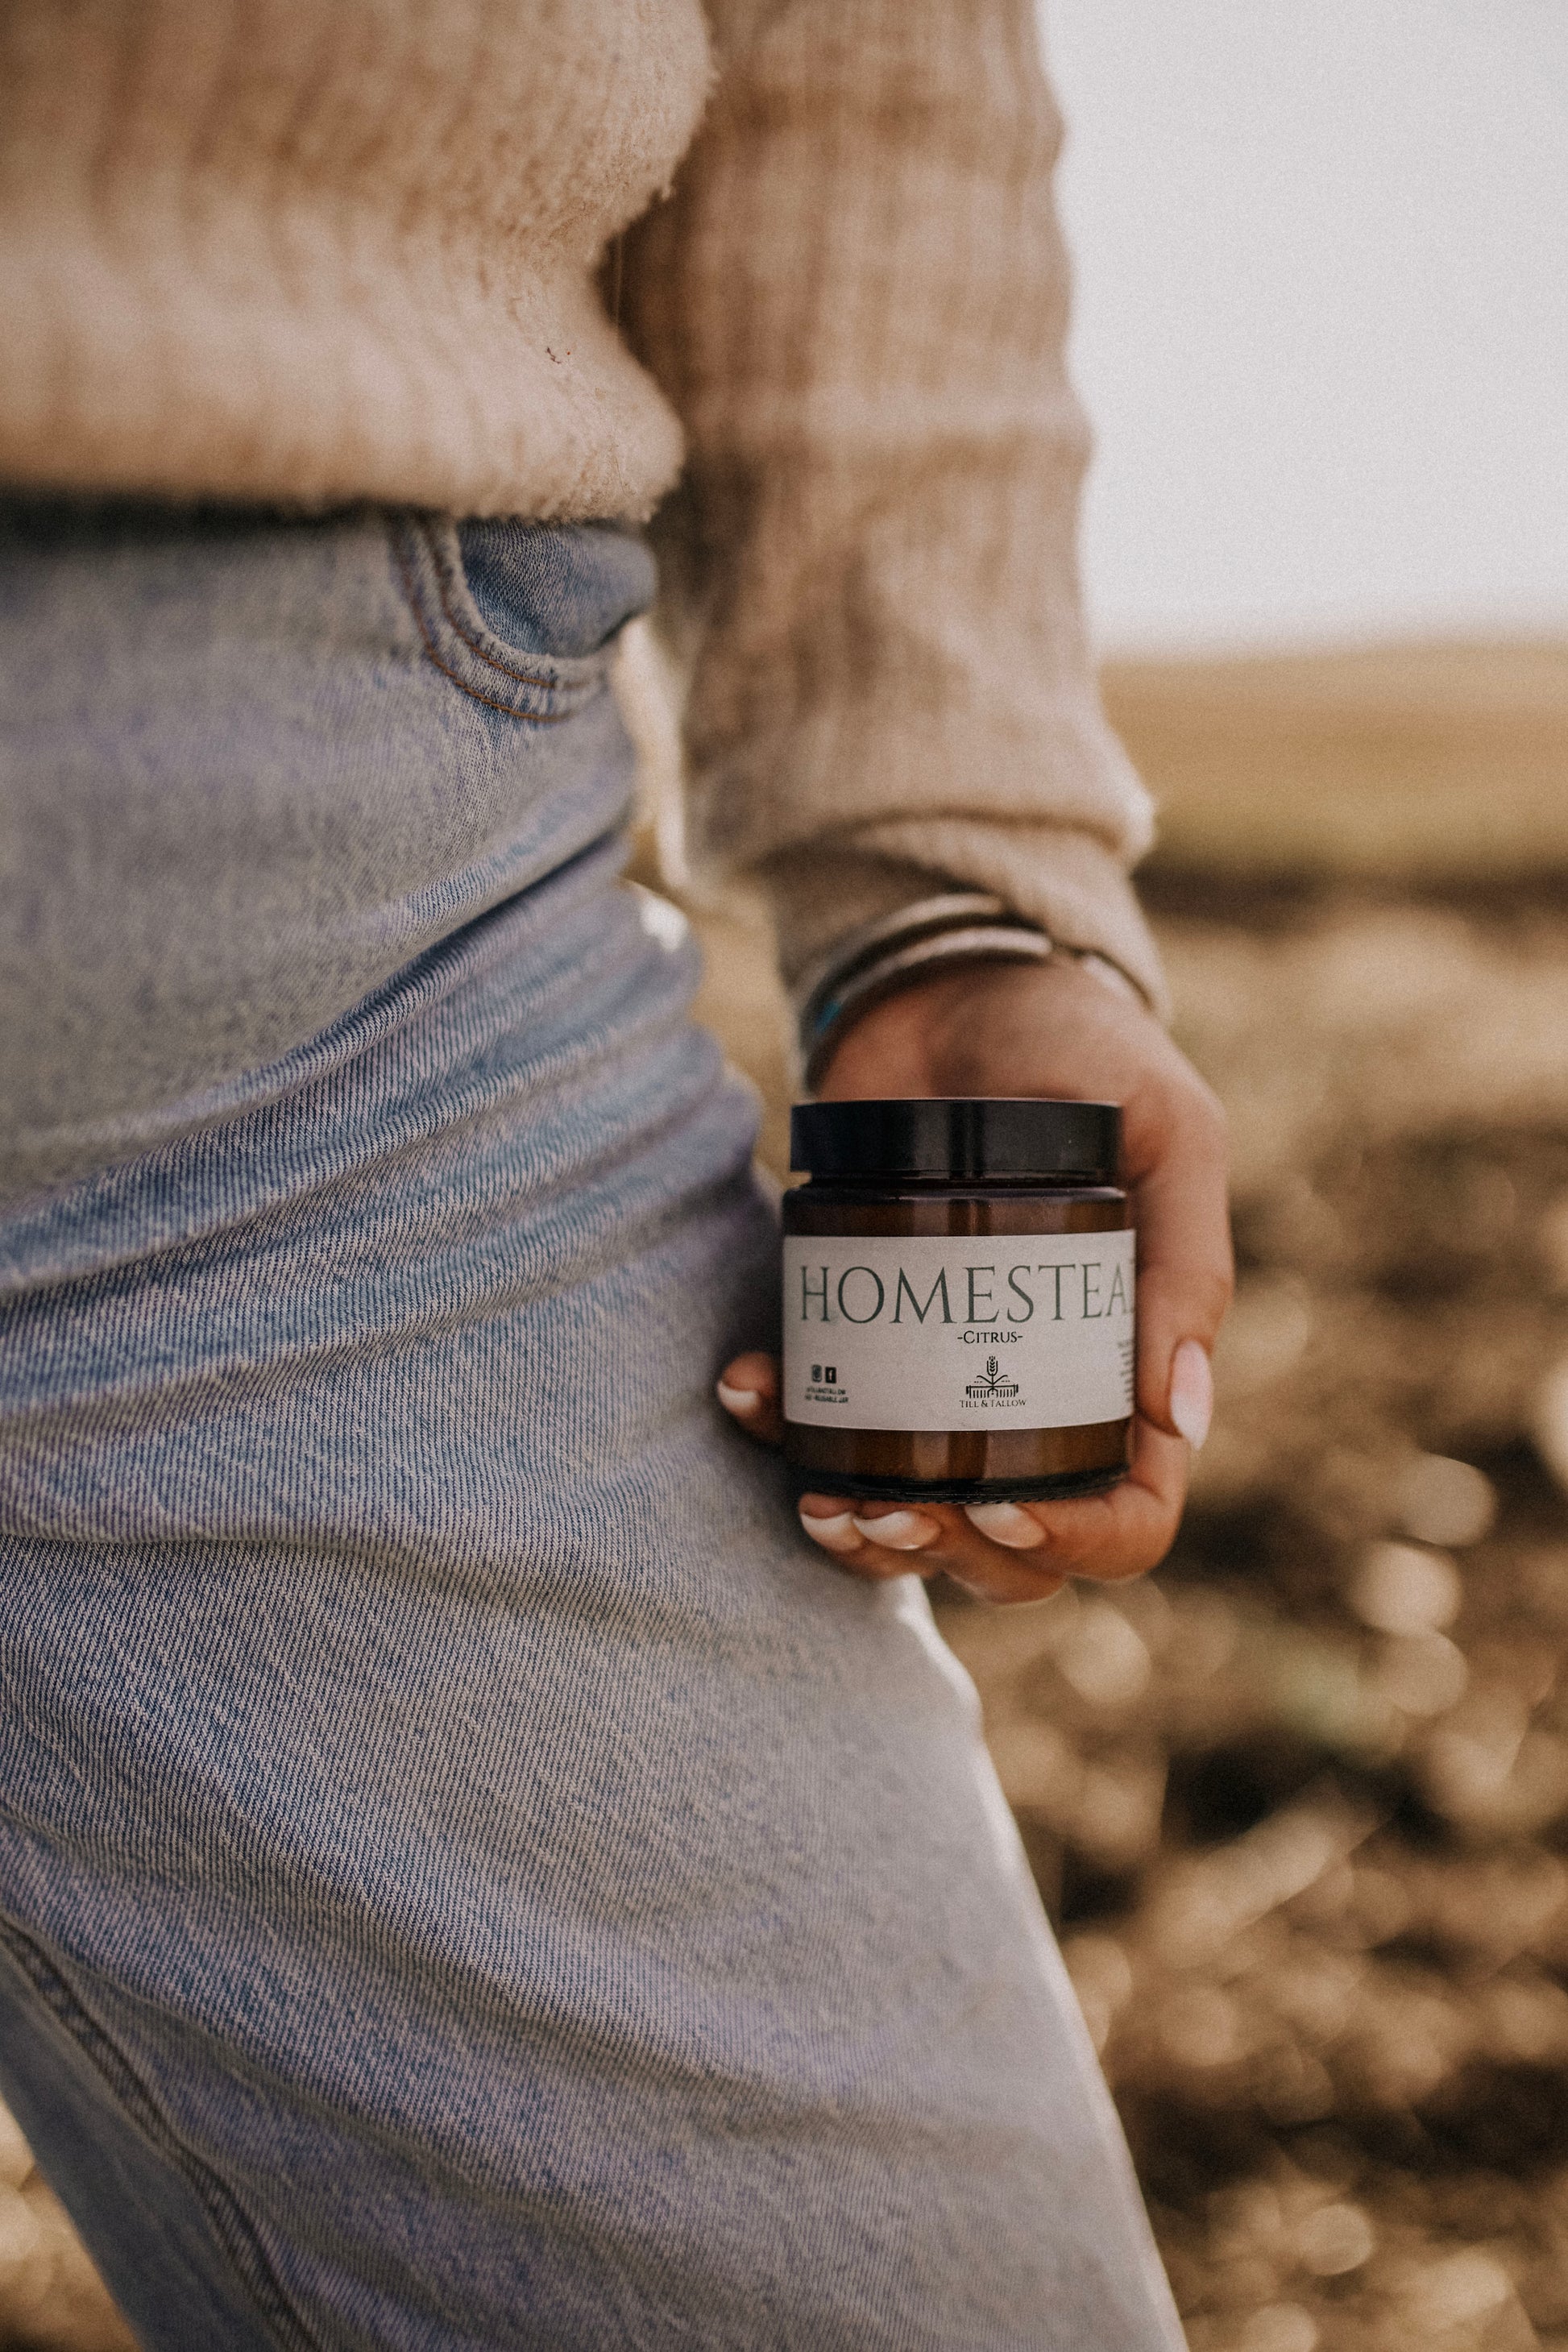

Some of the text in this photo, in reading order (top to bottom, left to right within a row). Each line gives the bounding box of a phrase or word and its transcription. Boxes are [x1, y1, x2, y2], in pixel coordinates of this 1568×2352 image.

[800, 1263, 1135, 1324] HOMESTEA
[960, 1399, 1027, 1408] TILL & TALLOW
